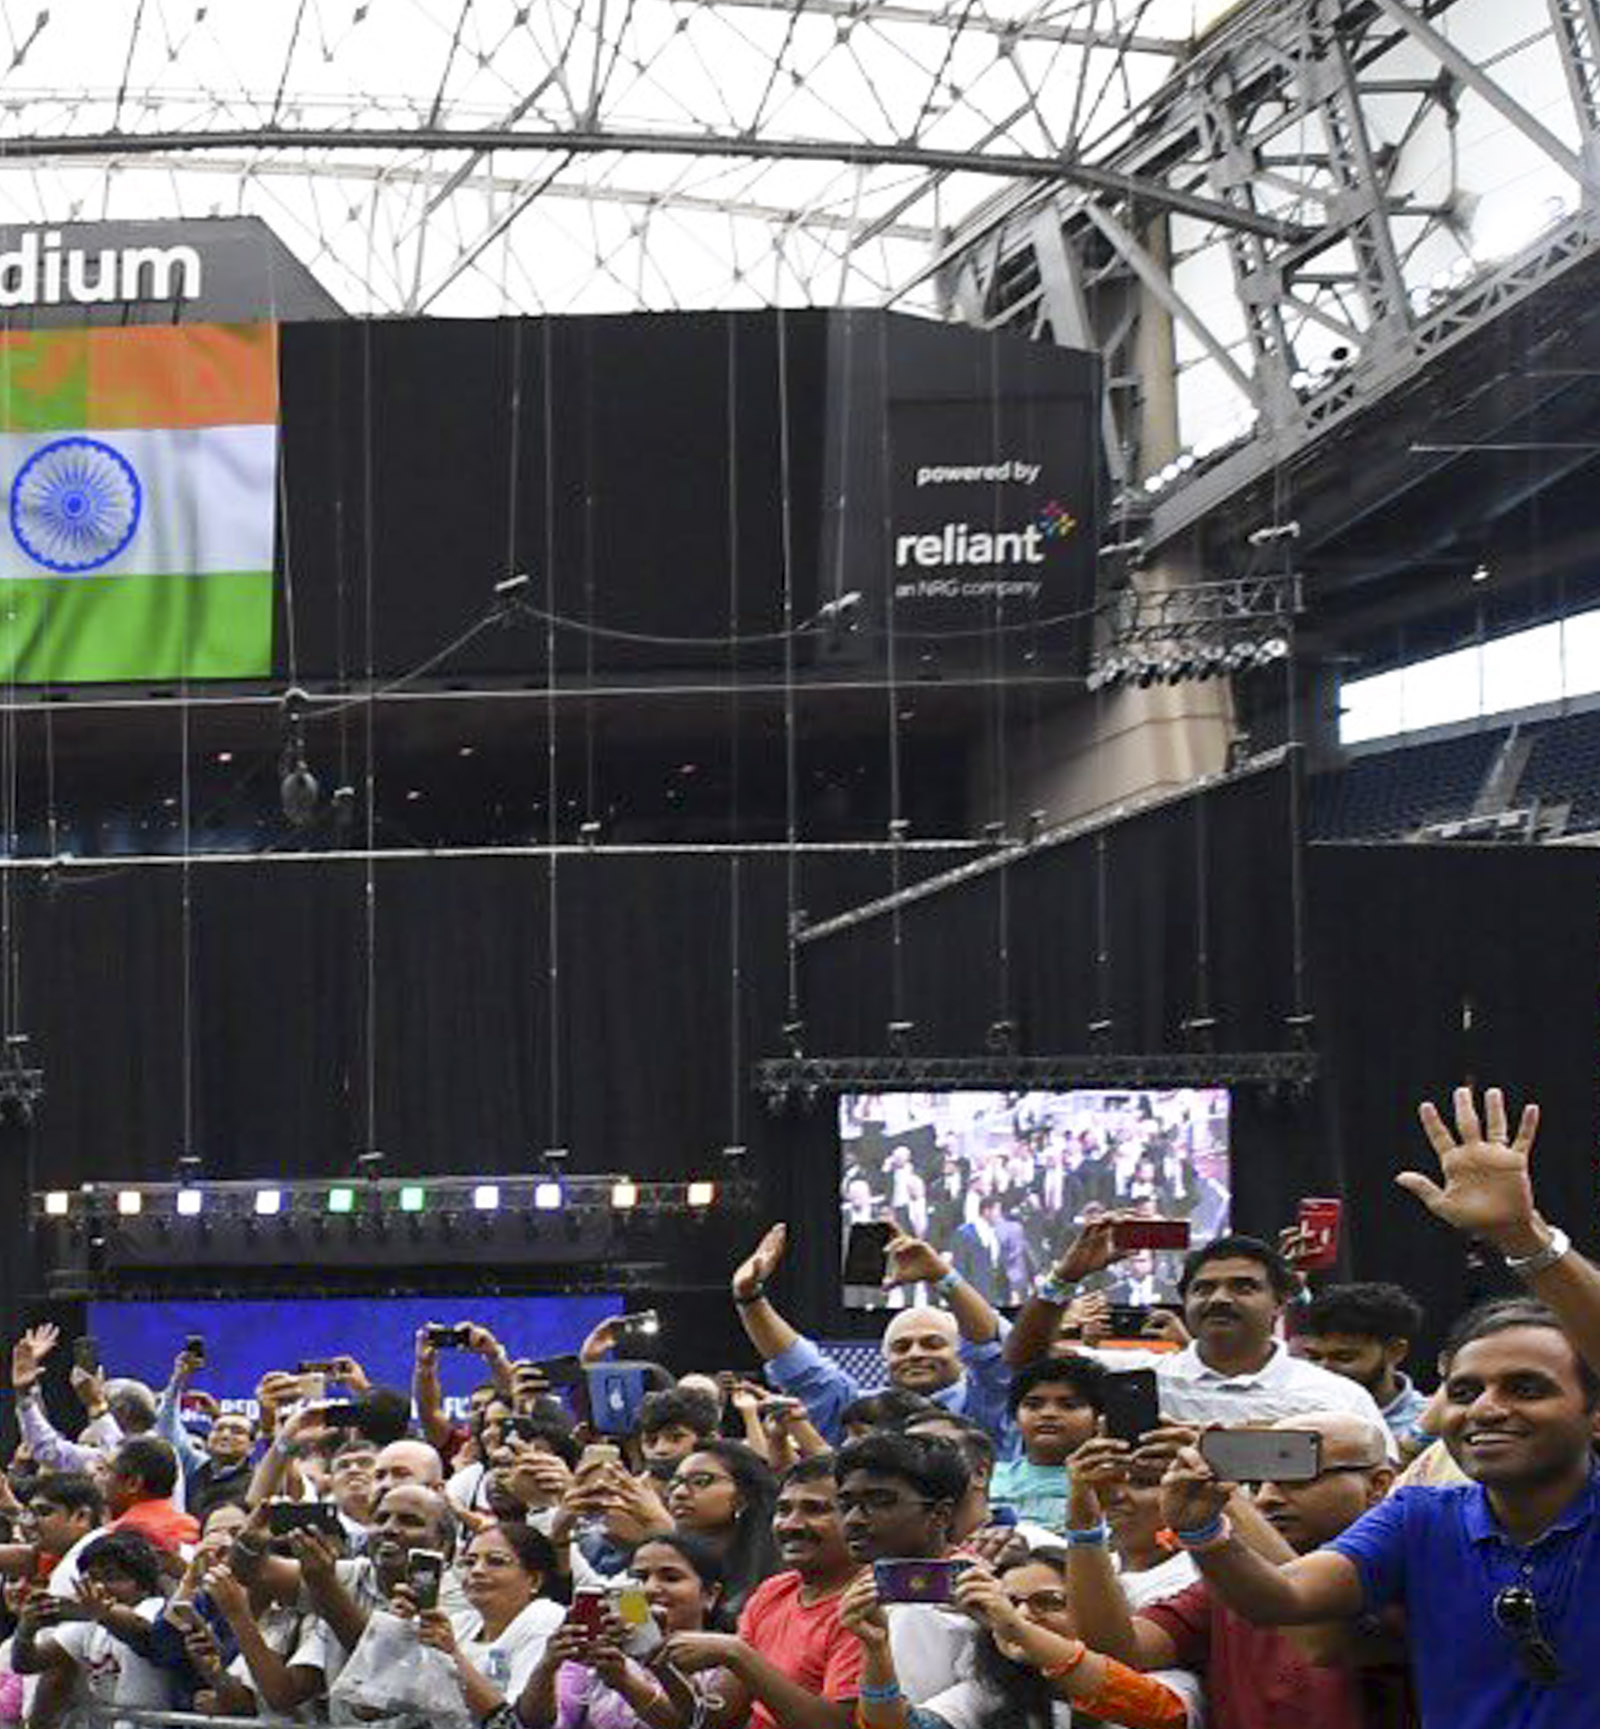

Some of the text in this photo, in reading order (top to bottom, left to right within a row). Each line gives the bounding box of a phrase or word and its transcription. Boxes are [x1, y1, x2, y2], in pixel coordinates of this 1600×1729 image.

[917, 460, 1042, 486] powered by
[896, 523, 1045, 567] reliant
[918, 578, 959, 597] NRG
[962, 580, 1042, 598] company
